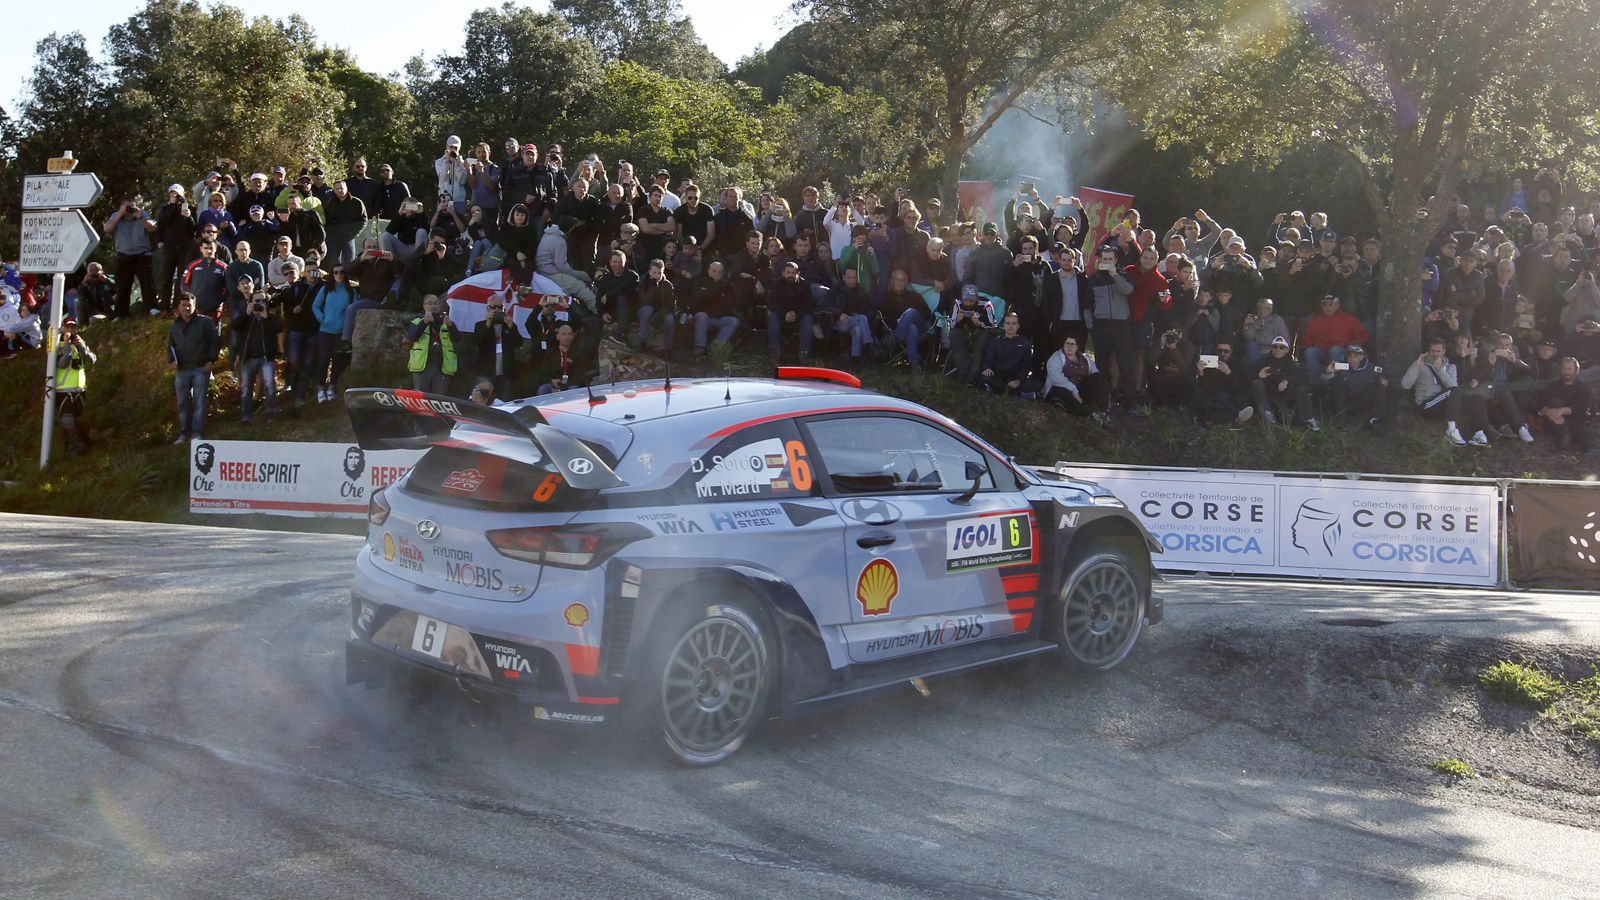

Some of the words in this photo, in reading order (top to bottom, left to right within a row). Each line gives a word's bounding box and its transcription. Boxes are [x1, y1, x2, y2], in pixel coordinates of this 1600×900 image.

[26, 181, 42, 190] PILA
[391, 394, 462, 416] HYUNDAI
[219, 461, 301, 484] REBELSPIRIT
[690, 456, 710, 473] D.
[784, 440, 812, 491] 6
[193, 475, 215, 492] Che
[370, 465, 410, 487] REBE
[340, 480, 365, 498] Che
[532, 473, 563, 502] 6
[695, 481, 717, 498] M.
[1199, 493, 1247, 503] Territoriale
[1250, 495, 1263, 503] de
[636, 512, 678, 521] HYUNDAI
[732, 507, 782, 519] HYUNDAI
[1140, 500, 1264, 523] CORSE
[1411, 502, 1461, 513] Territoriale
[1464, 505, 1479, 513] de
[737, 518, 775, 528] STEEL
[1352, 509, 1478, 533] CORSE
[953, 523, 998, 551] IGOL
[1009, 518, 1021, 547] 6
[433, 545, 473, 562] HYUNDAI
[1352, 541, 1478, 566] CORSICA
[400, 556, 423, 573] ULTRA
[446, 560, 503, 591] MOBIS
[421, 620, 438, 652] 6
[866, 633, 919, 653] HYUNDAI
[920, 614, 984, 648] MOBIS
[485, 643, 516, 655] HYUNDAI
[552, 712, 605, 722] MICHELIN
